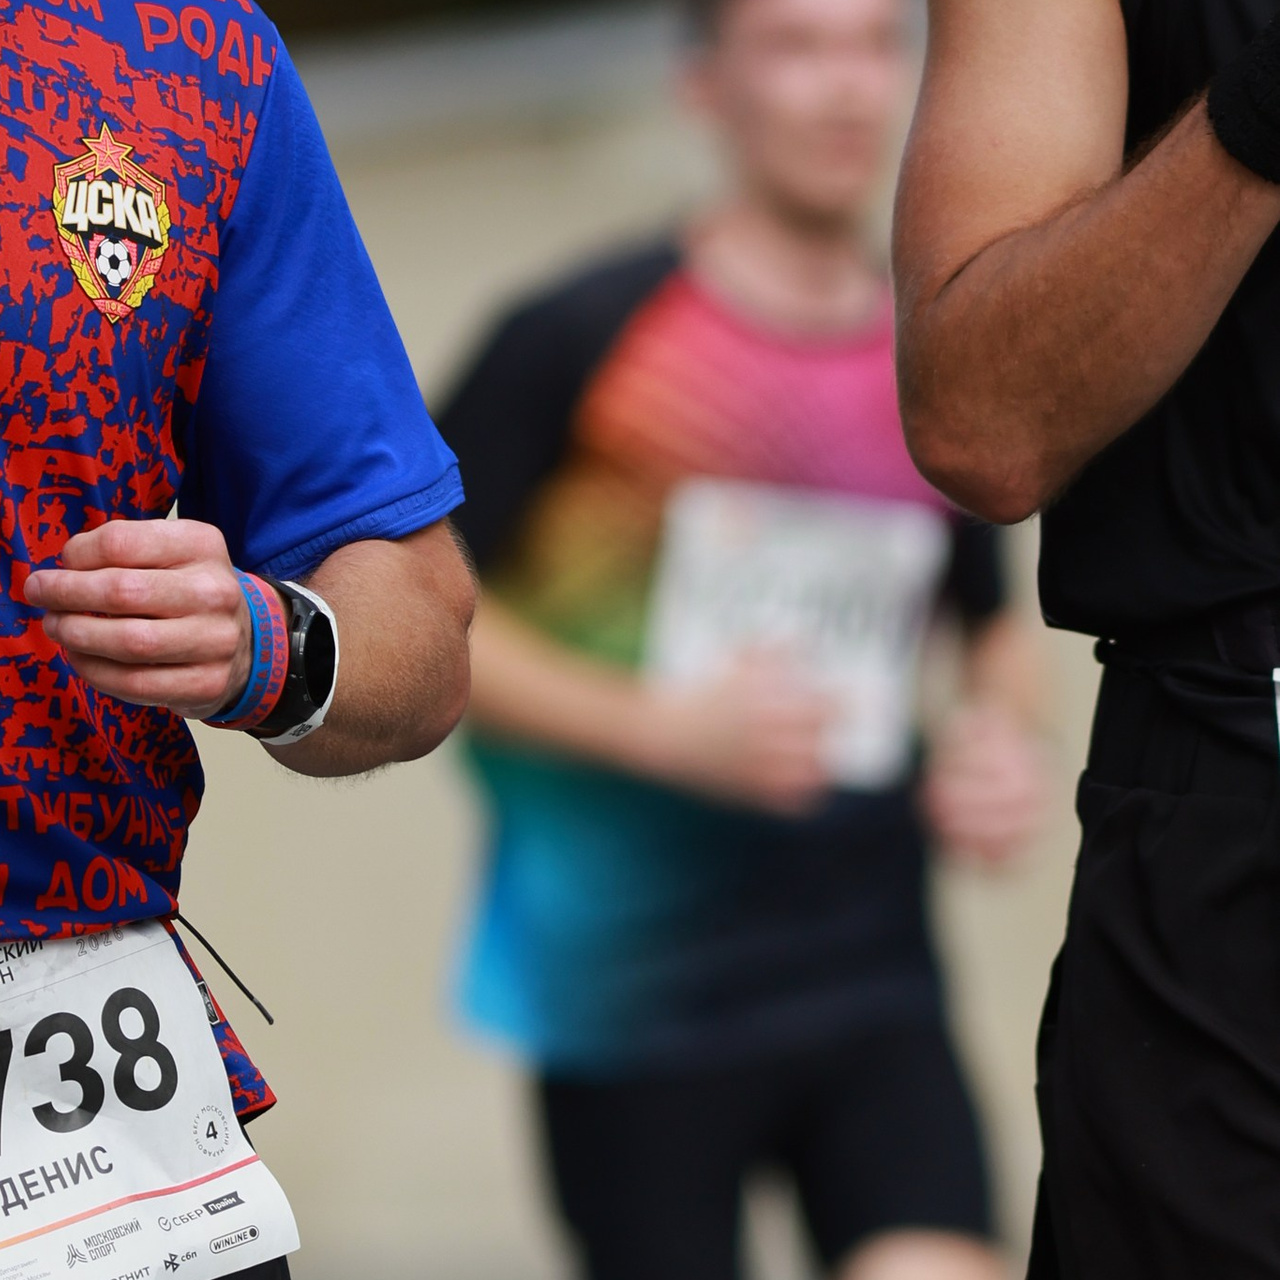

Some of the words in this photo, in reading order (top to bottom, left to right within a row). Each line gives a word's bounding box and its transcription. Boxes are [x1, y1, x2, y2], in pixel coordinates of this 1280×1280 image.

[61, 179, 164, 245] ЦСКА
[35, 854, 148, 912] ДОМ
[75, 926, 124, 957] 2026
[206, 1120, 219, 1140] 4
[172, 1207, 205, 1227] СБЕР
[208, 1196, 237, 1213] Прайм
[83, 1217, 143, 1250] МОСКОВСКИЙ
[212, 1230, 249, 1251] WINLINE
[88, 1241, 118, 1262] СПОРТ
